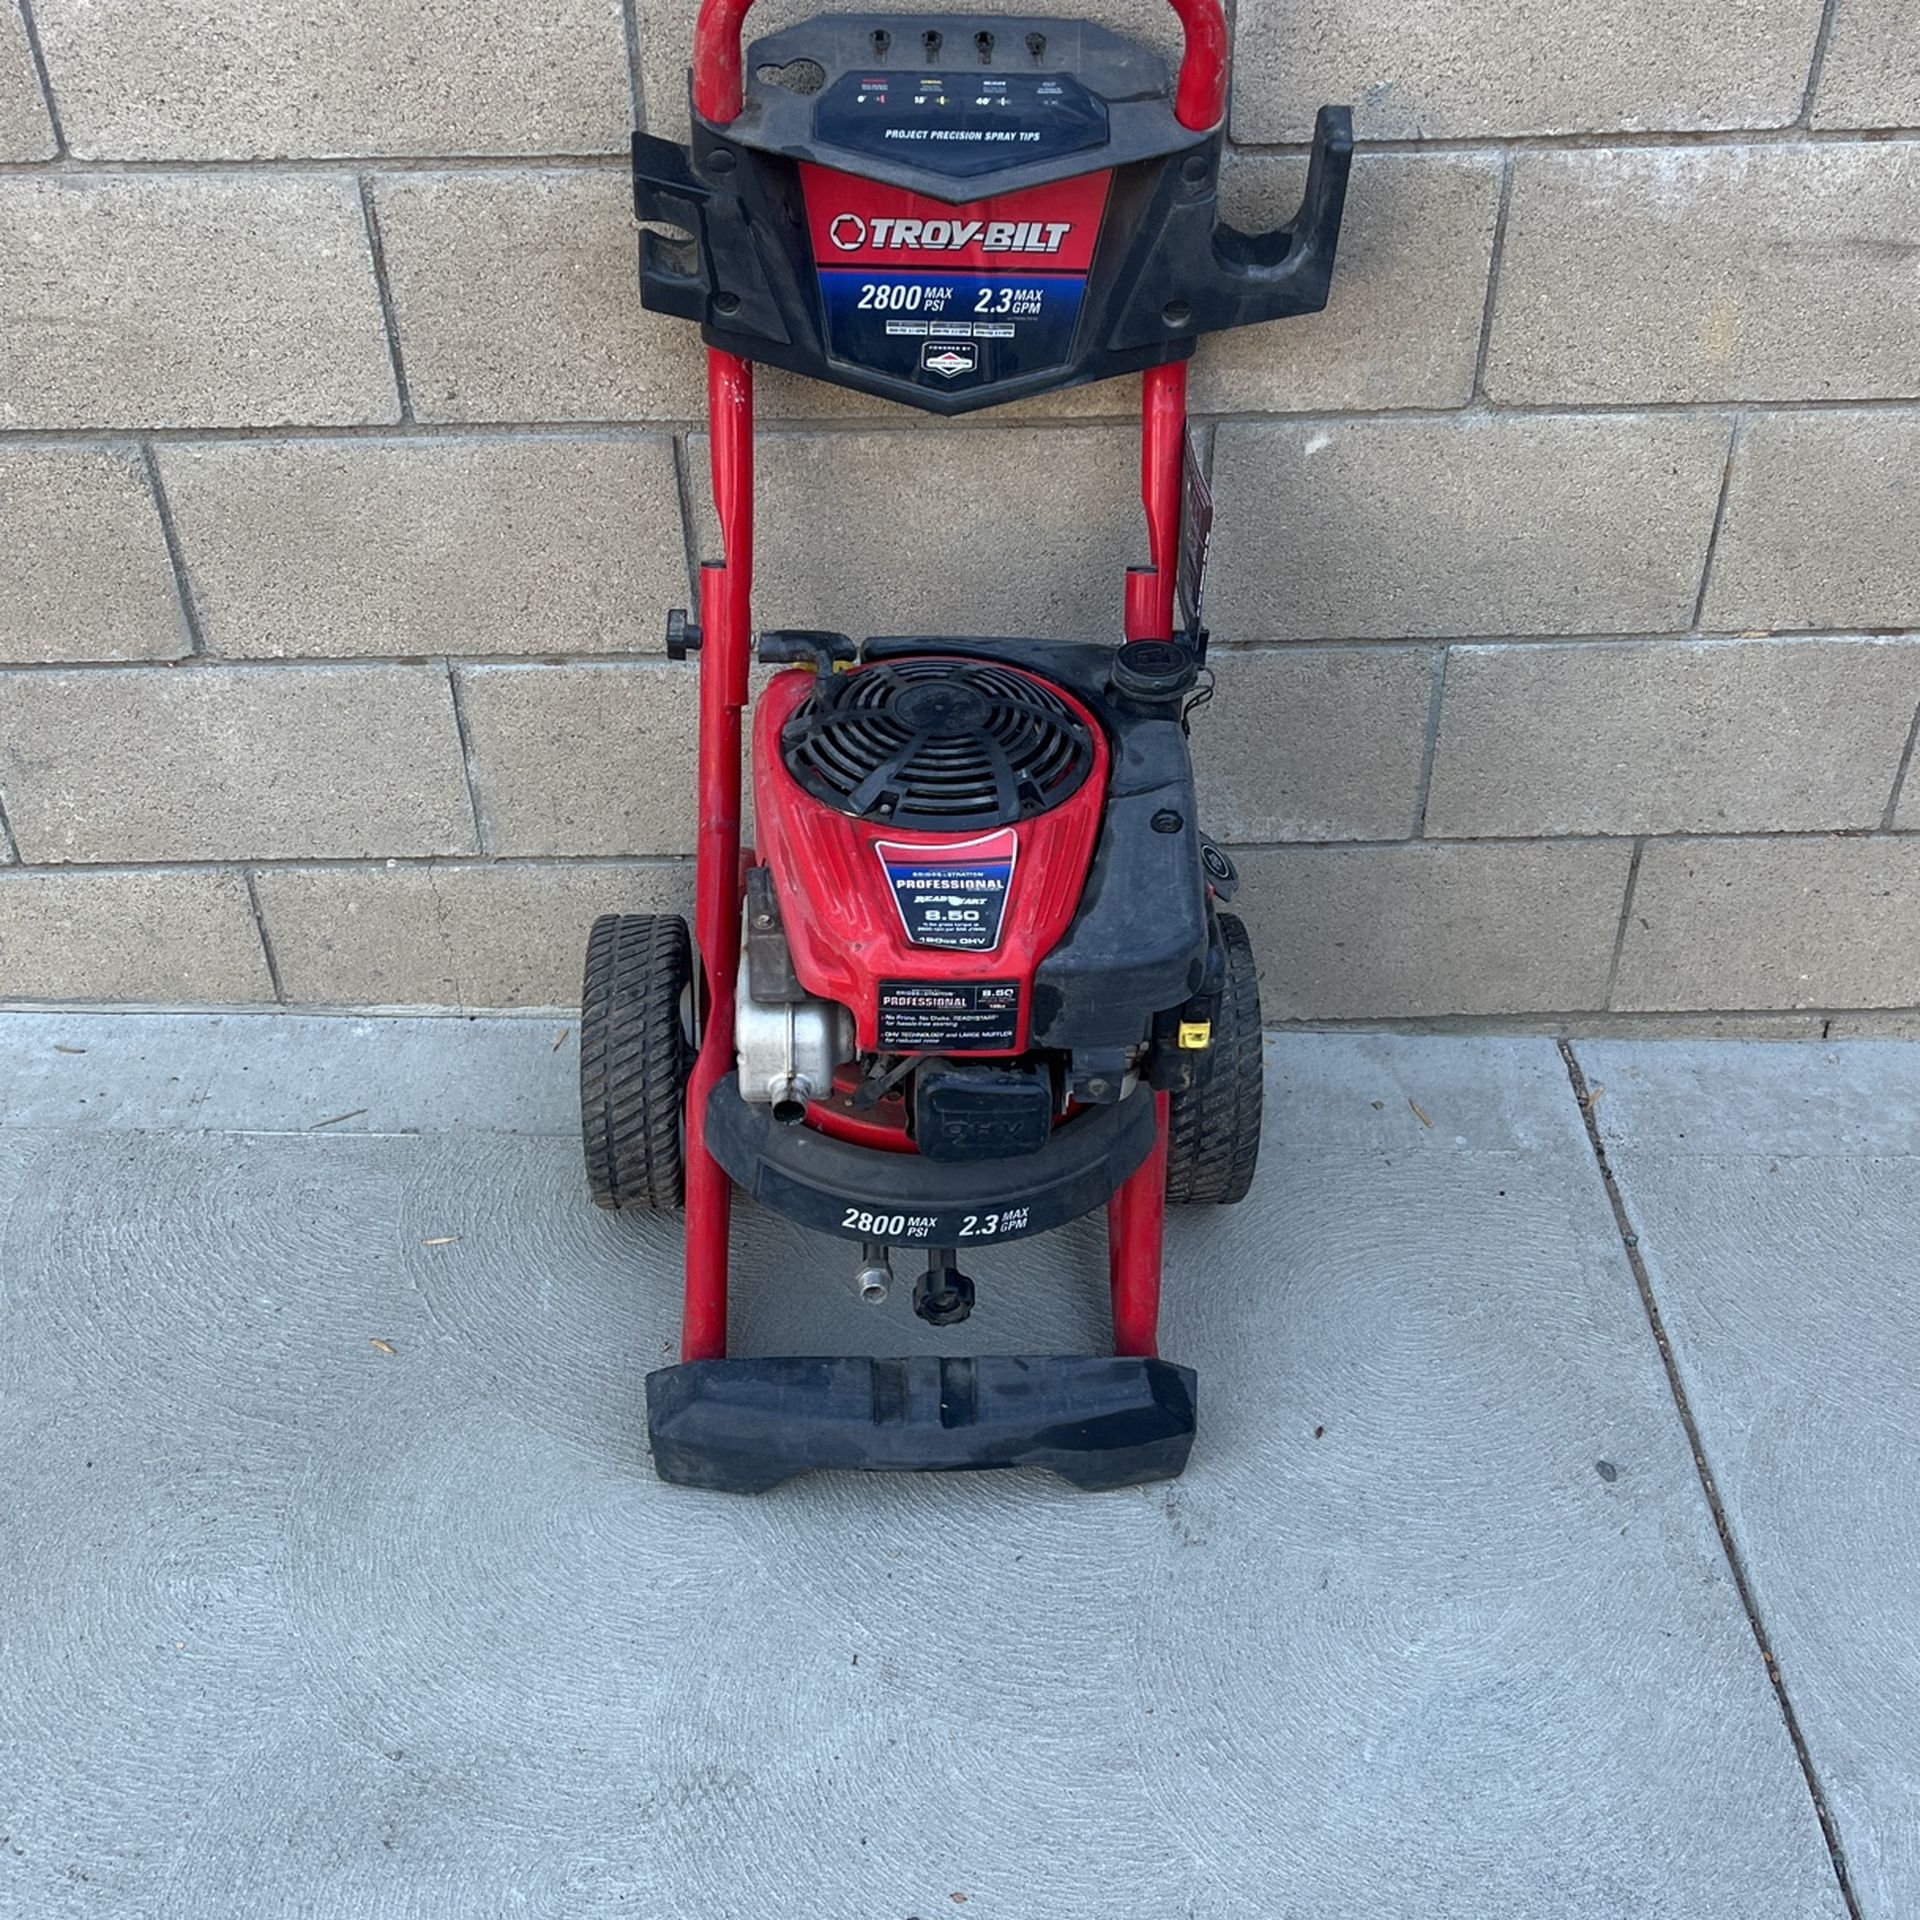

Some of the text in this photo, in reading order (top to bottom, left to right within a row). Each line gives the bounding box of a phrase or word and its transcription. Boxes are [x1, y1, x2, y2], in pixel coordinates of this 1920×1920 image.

[885, 129, 1041, 141] PROJECT PRECISION SPRAY TIPS
[869, 218, 1071, 253] TROY-BILT
[857, 284, 954, 312] 2800 MAX PSI
[974, 288, 1044, 315] 2.3 MAX GPM
[896, 879, 1005, 889] PROFESSIONAL
[924, 910, 980, 921] 8.50
[883, 996, 967, 1007] PROFESSIONAL
[982, 988, 1014, 997] 8.50
[841, 1207, 938, 1238] 2800 MAX PSI
[958, 1207, 1030, 1237] 2.3 MAX GPM
